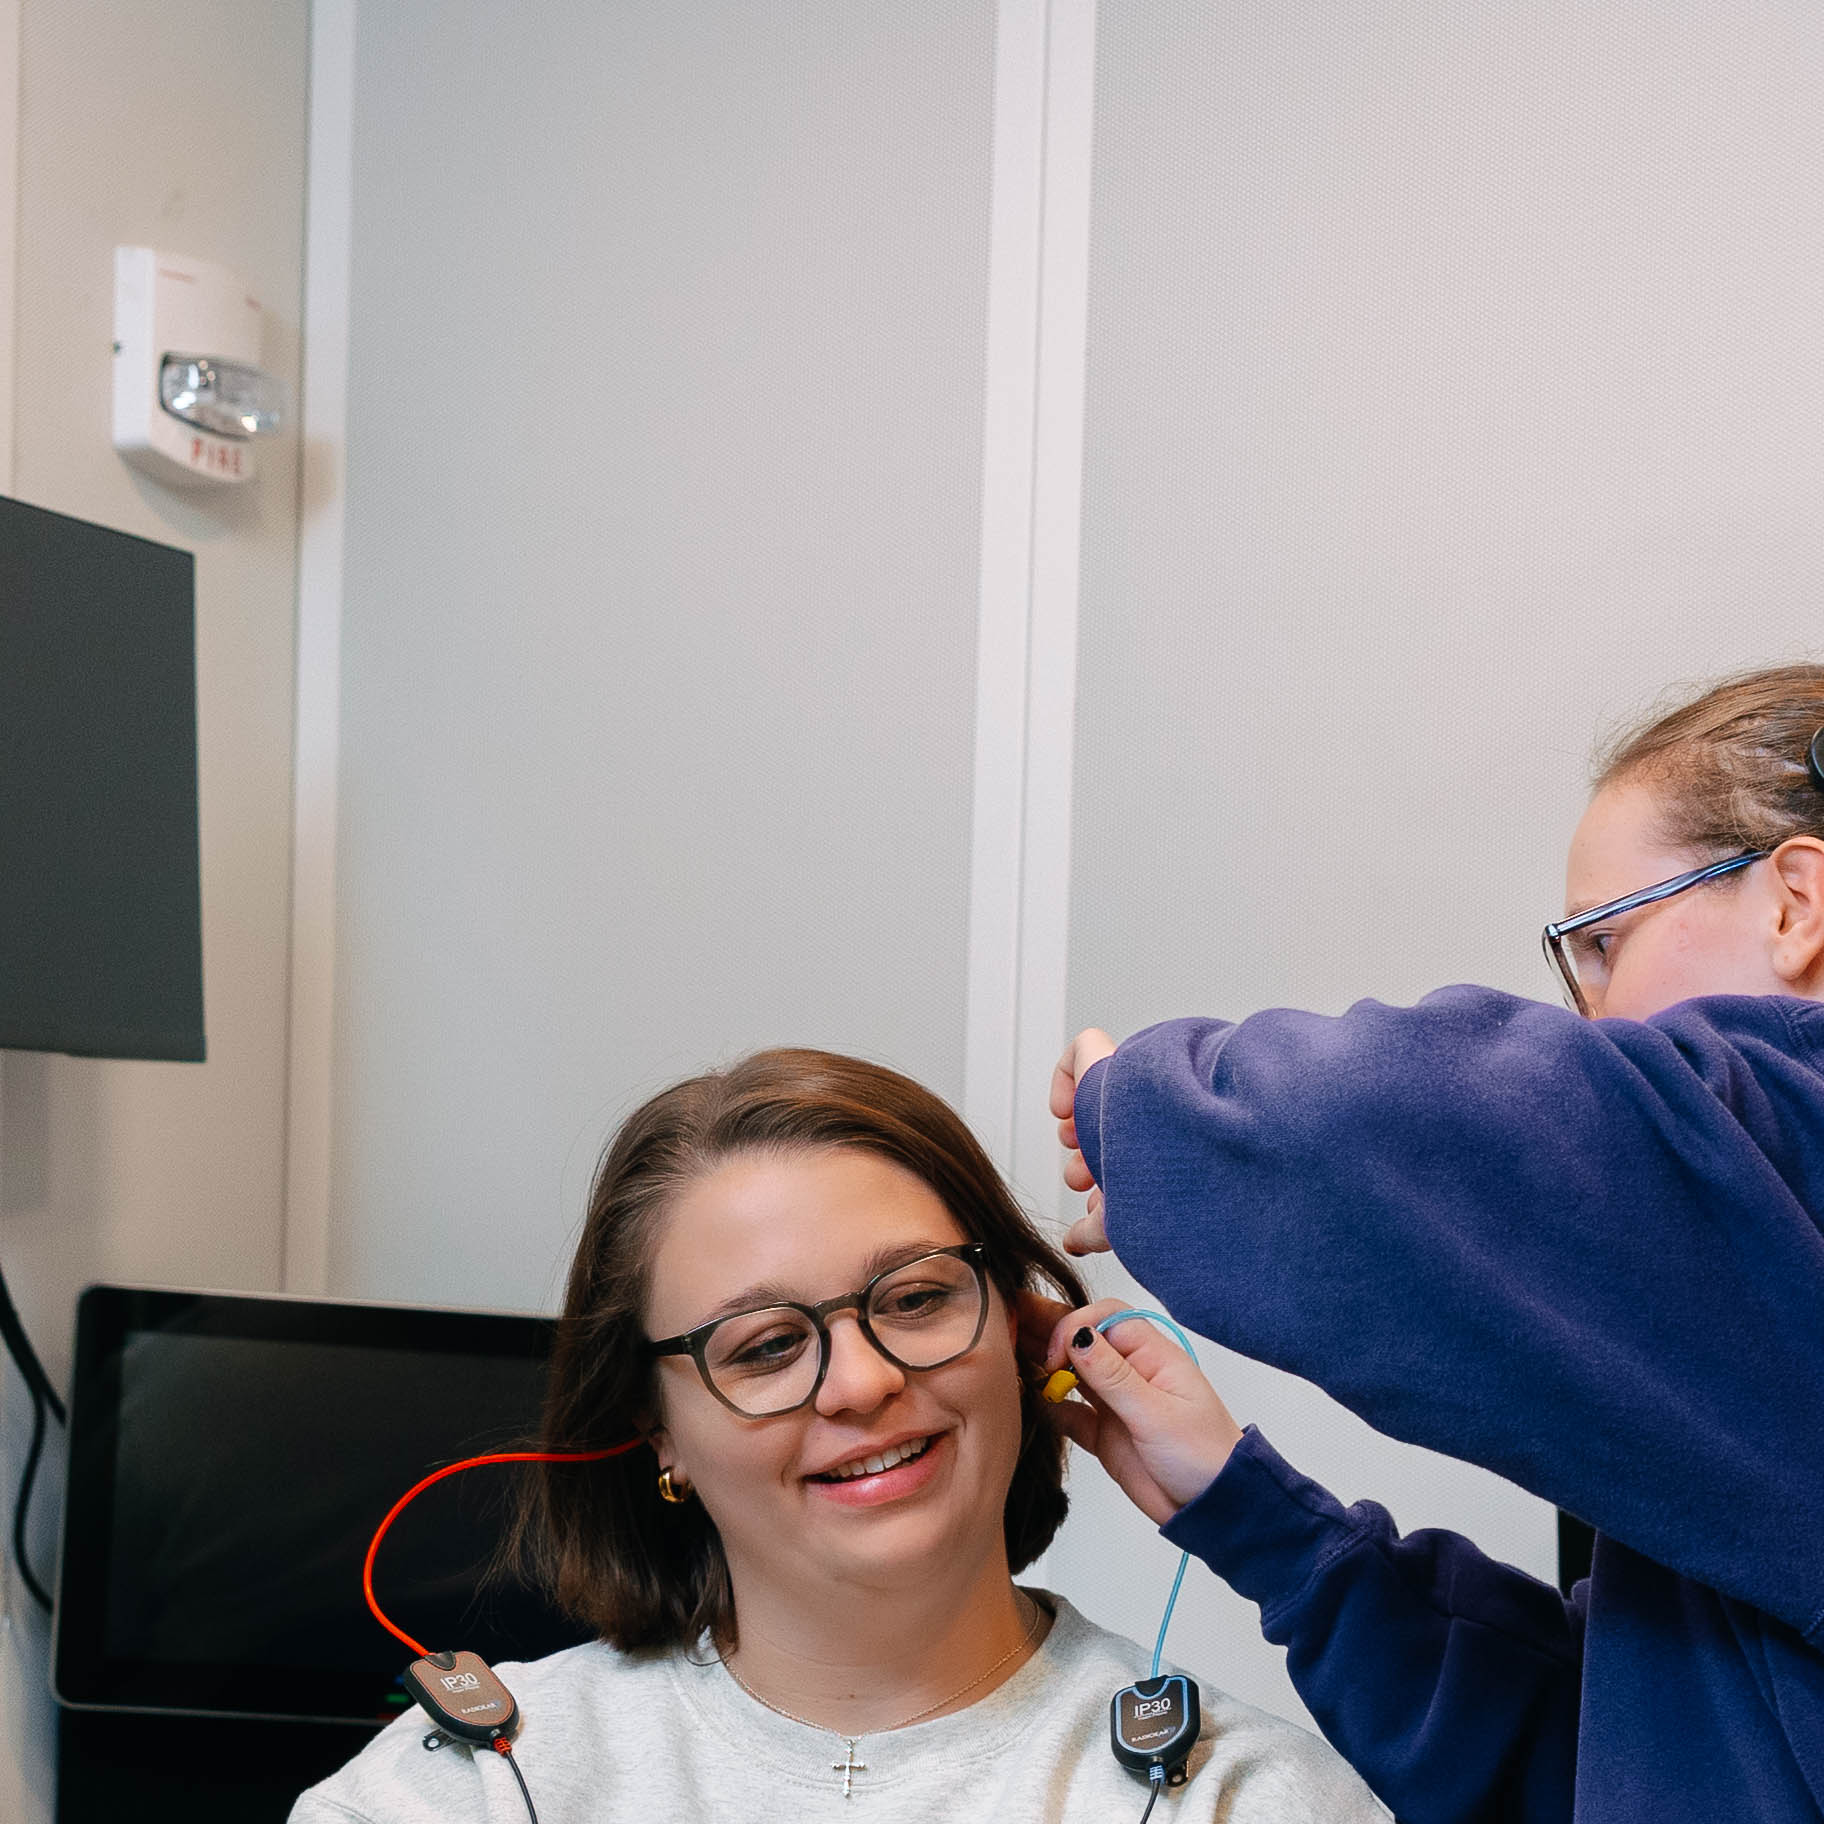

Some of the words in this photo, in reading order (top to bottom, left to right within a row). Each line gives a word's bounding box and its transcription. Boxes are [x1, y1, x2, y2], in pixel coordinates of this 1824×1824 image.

[191, 437, 242, 476] FIRE
[440, 1672, 479, 1690] IP30
[1134, 1697, 1171, 1717] IP30
